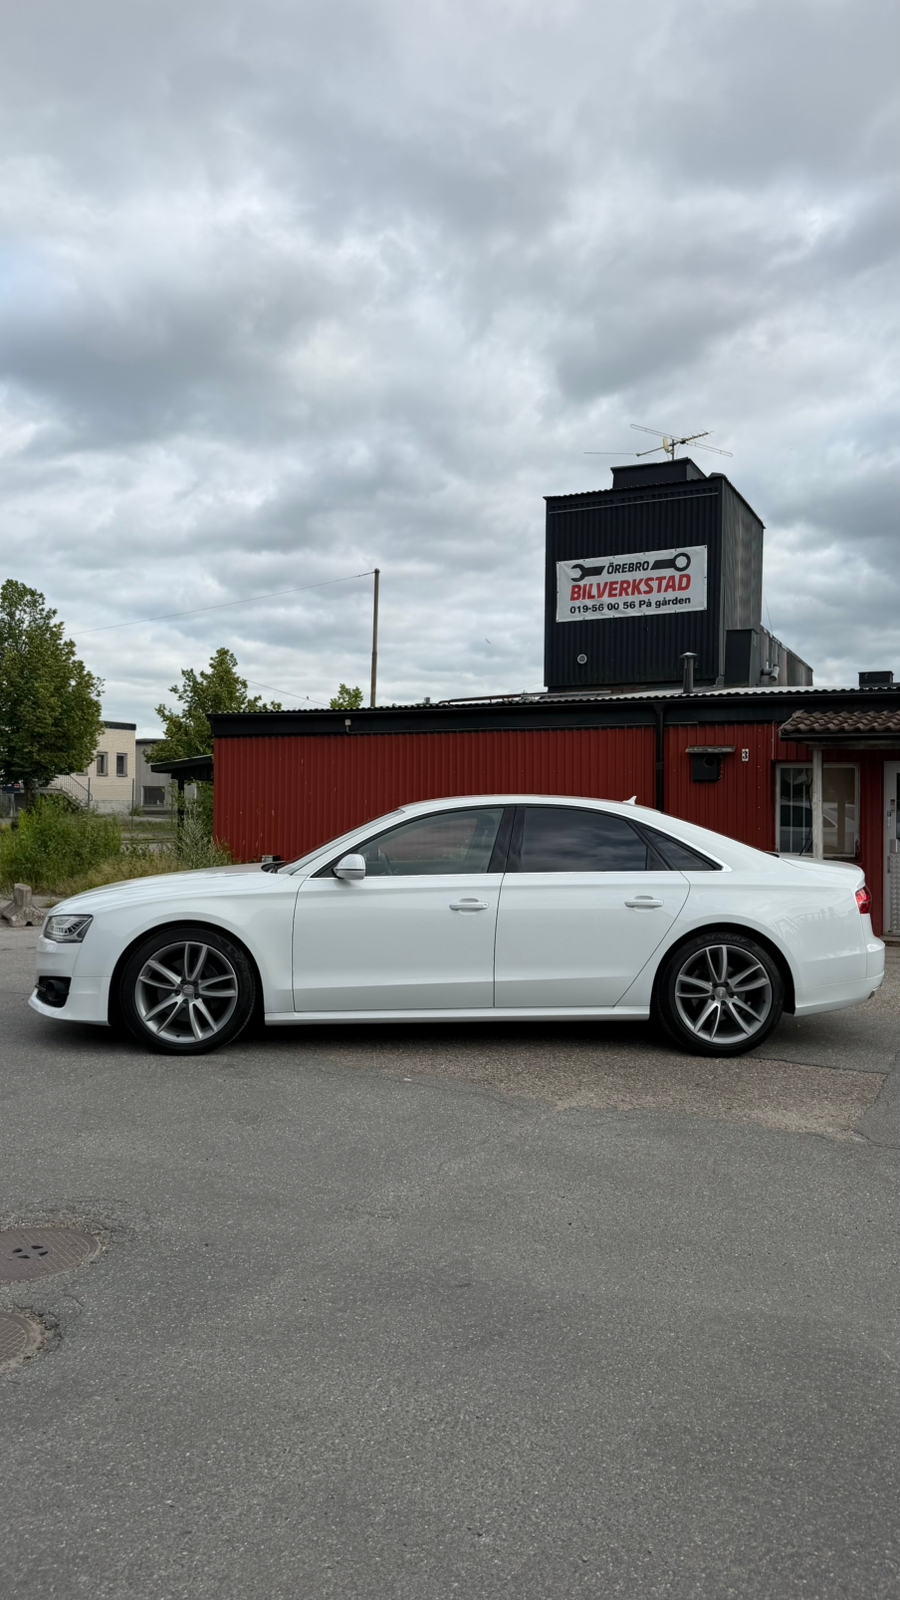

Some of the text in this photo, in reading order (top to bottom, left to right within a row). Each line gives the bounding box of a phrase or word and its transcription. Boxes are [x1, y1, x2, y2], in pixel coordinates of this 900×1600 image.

[606, 561, 650, 574] ÖREBRO
[570, 574, 691, 601] BILVERKSTAD
[570, 597, 691, 613] 019-56 00 56 På gården
[742, 750, 748, 760] 3
